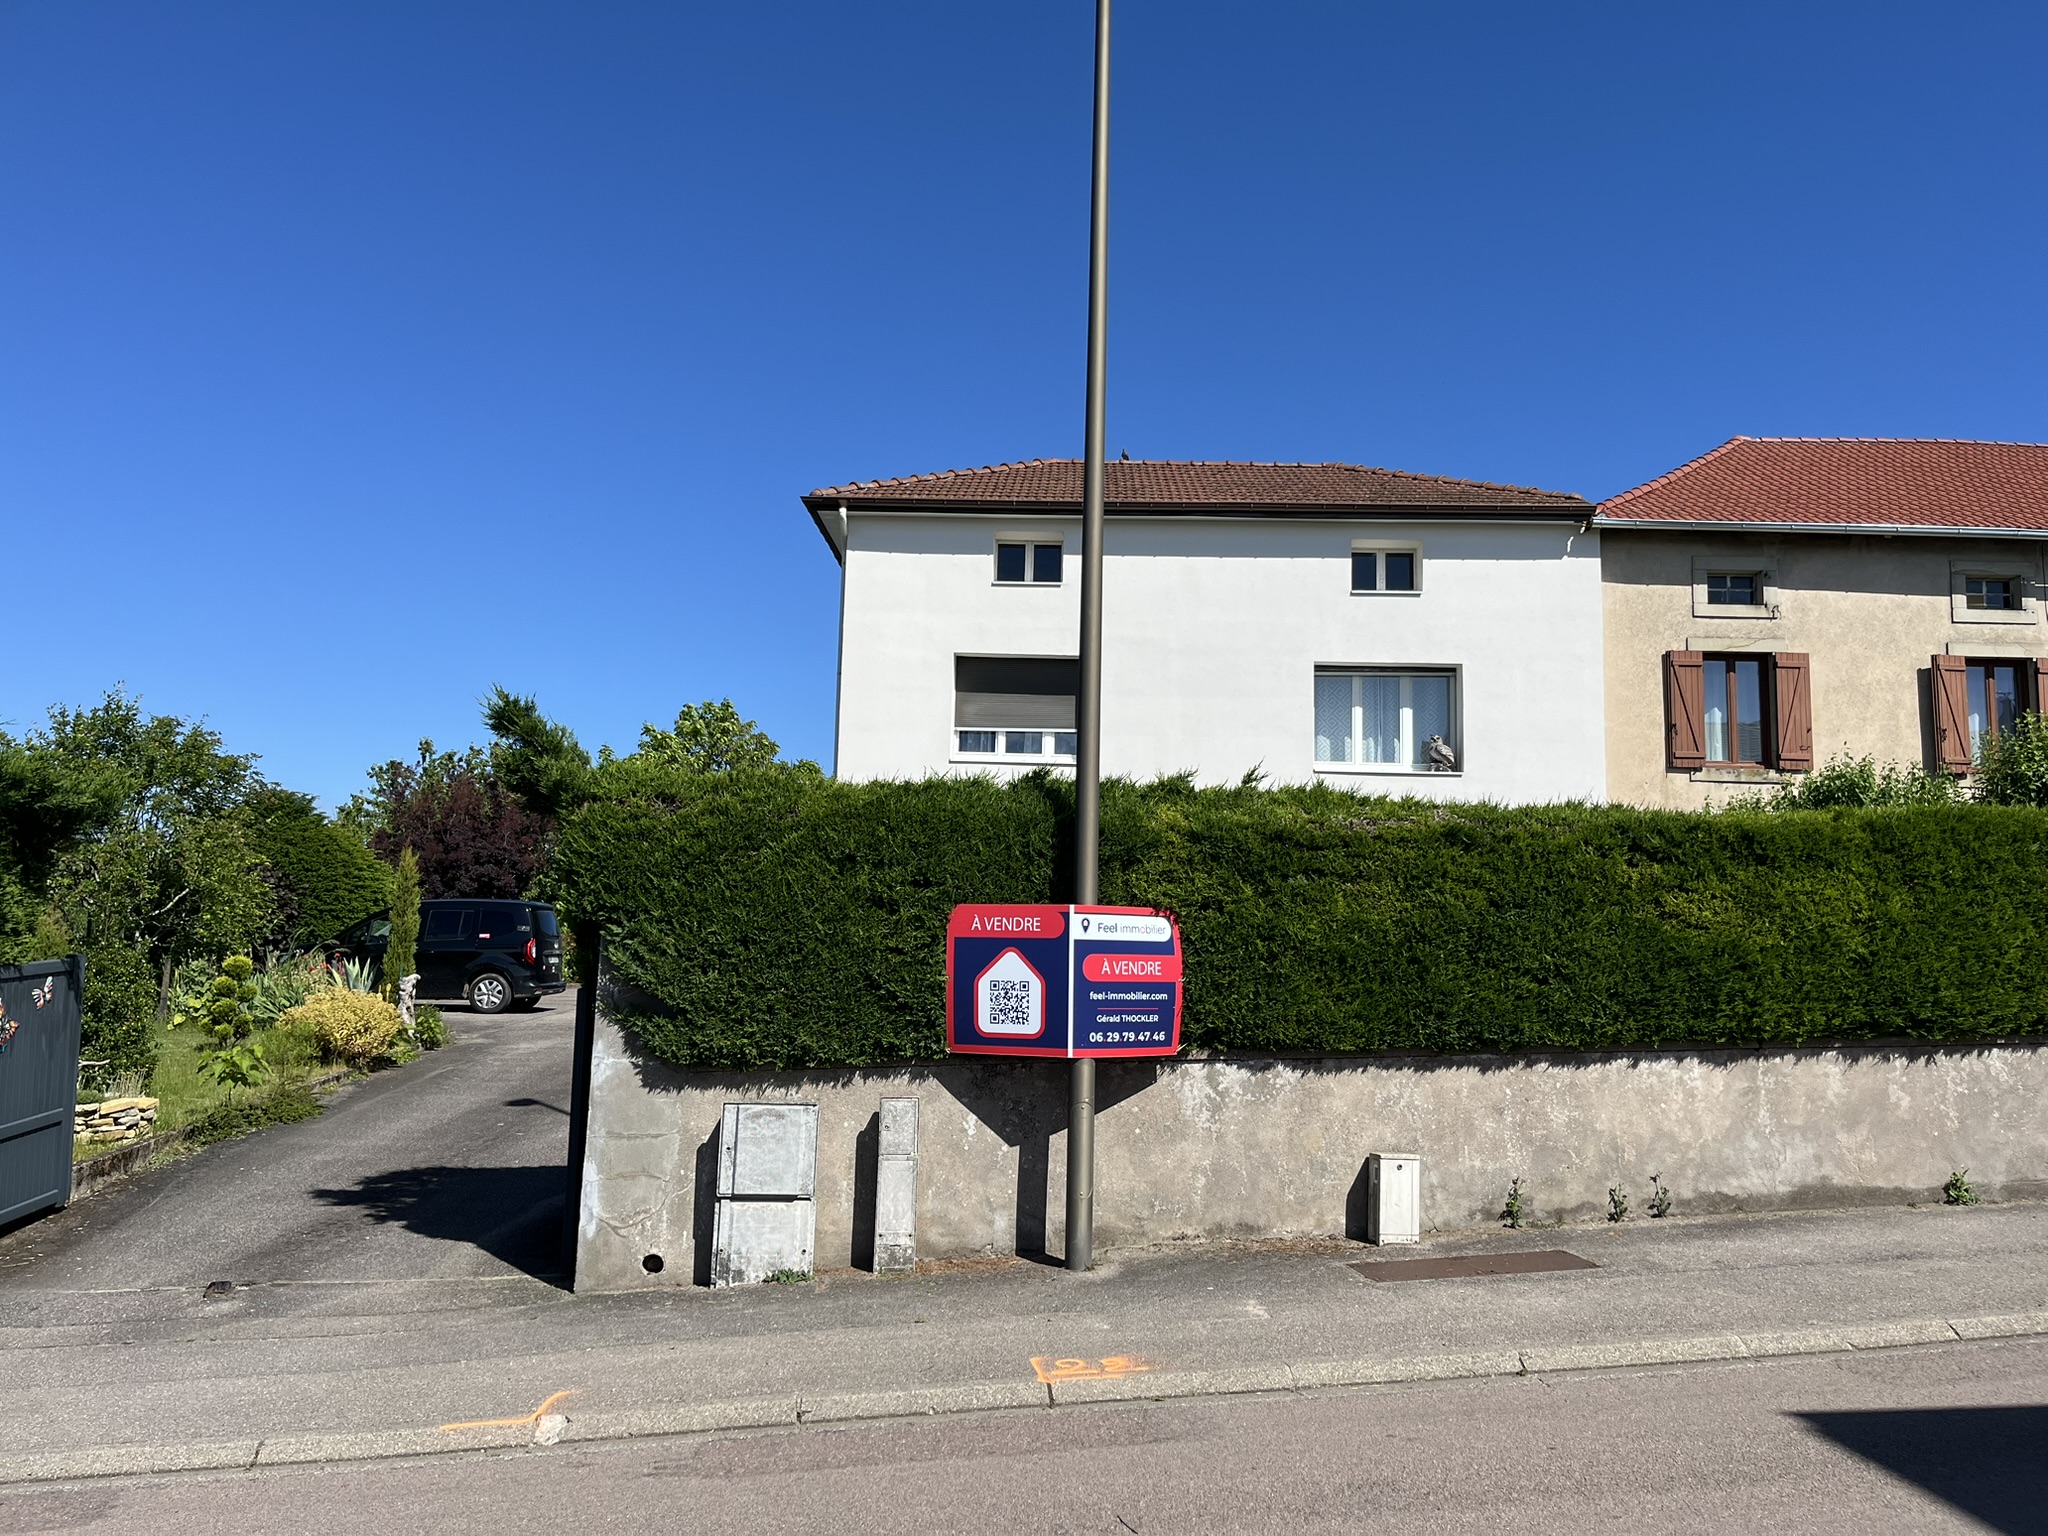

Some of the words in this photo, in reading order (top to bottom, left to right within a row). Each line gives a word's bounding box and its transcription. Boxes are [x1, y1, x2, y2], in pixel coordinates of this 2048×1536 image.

[971, 914, 982, 931] À
[984, 917, 1041, 932] VENDRE
[1097, 922, 1118, 934] Feel
[1120, 923, 1166, 935] immobilier
[1101, 958, 1111, 975] À
[1112, 961, 1162, 976] VENDRE
[1089, 991, 1168, 1000] feel-immobilier.com
[1096, 1014, 1120, 1023] Gérald
[1121, 1014, 1159, 1022] THOCKLER
[1089, 1031, 1166, 1043] 06.29.79.47.46
